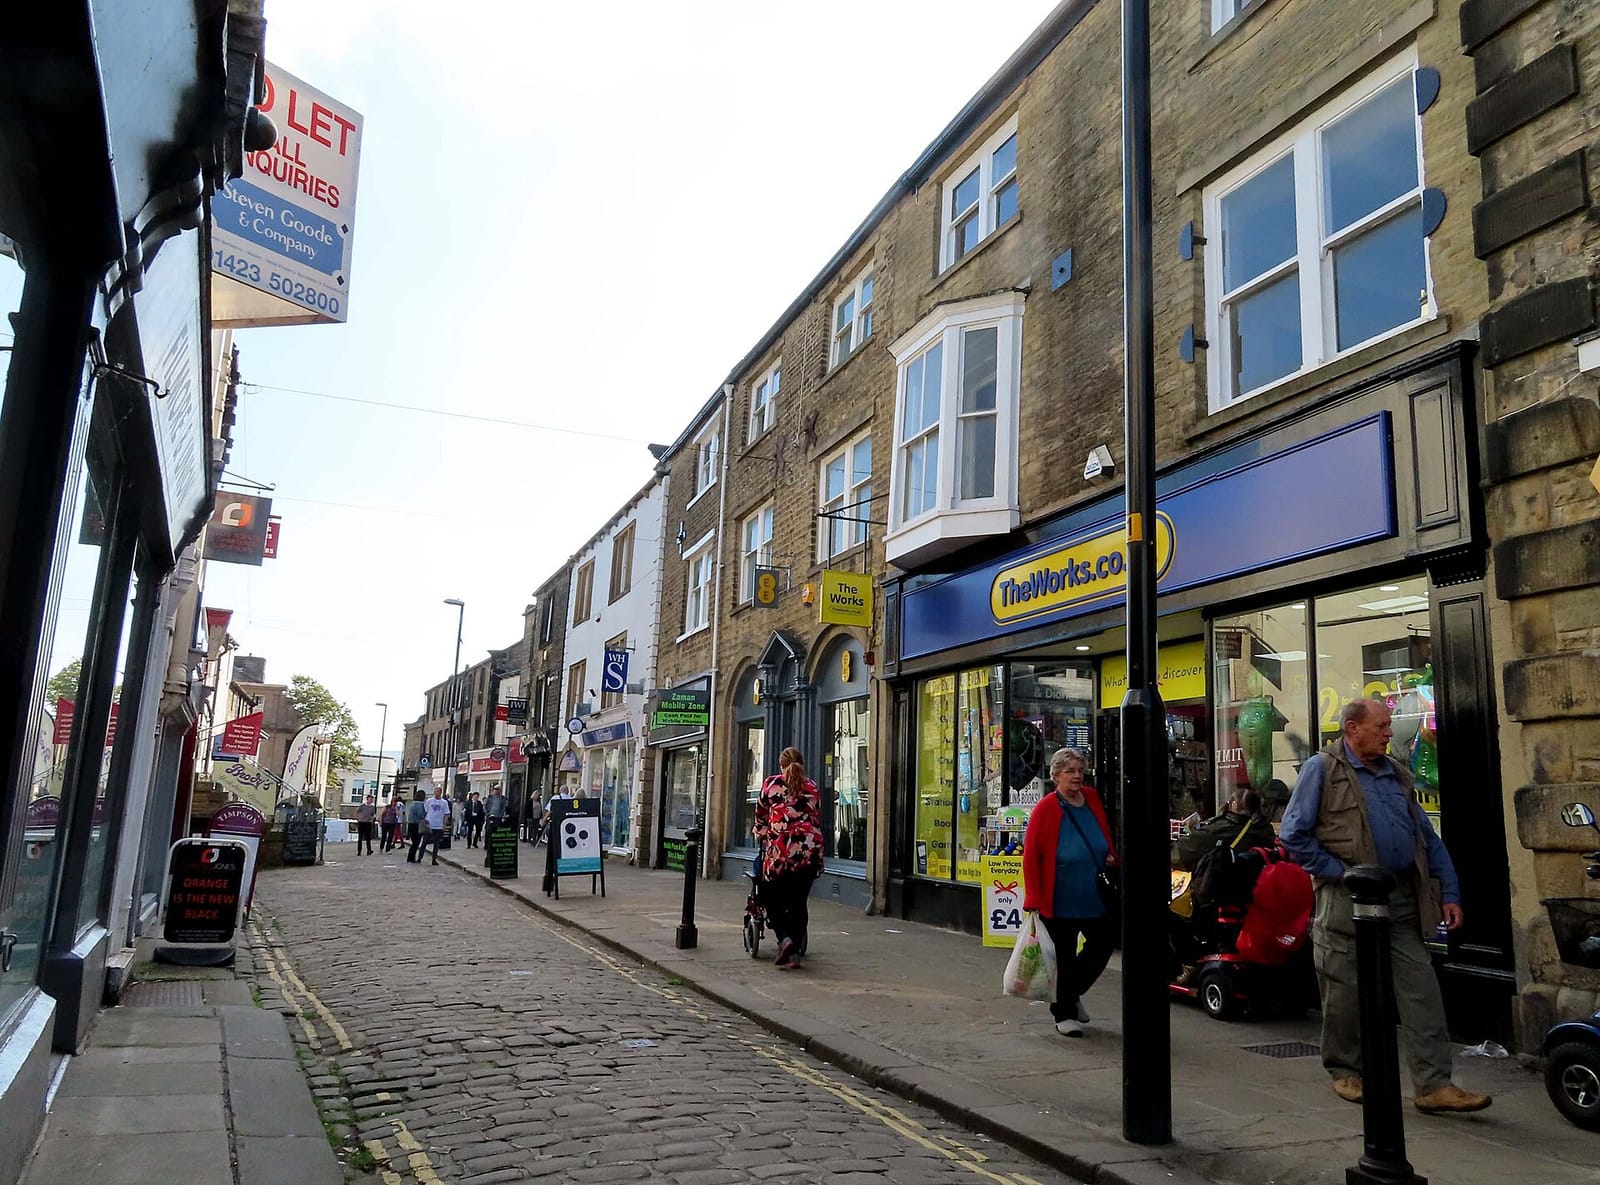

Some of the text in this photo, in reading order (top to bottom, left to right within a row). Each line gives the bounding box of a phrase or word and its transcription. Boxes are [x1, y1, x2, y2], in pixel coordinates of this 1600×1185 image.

[287, 89, 356, 157] LET
[246, 150, 341, 209] NQUIRIES
[222, 181, 333, 246] Steven Goode
[238, 210, 317, 260] & Company
[212, 250, 261, 283] 1423
[268, 271, 340, 315] 502800
[999, 551, 1128, 608] TheWorks.co.
[837, 582, 858, 595] The
[830, 593, 864, 607] Works
[608, 652, 626, 663] WH
[605, 661, 624, 691] S
[671, 692, 697, 702] Zaman
[661, 701, 706, 711] Mobile Zone
[225, 763, 274, 791] Brody's
[217, 810, 259, 825] TIMPSON
[1002, 860, 1022, 868] Prices
[990, 867, 1020, 876] Everyday
[183, 878, 229, 889] ORANGE
[173, 893, 236, 905] IS THE NEW
[997, 896, 1013, 905] only
[184, 909, 219, 920] BLACK
[990, 908, 1023, 930] £4
